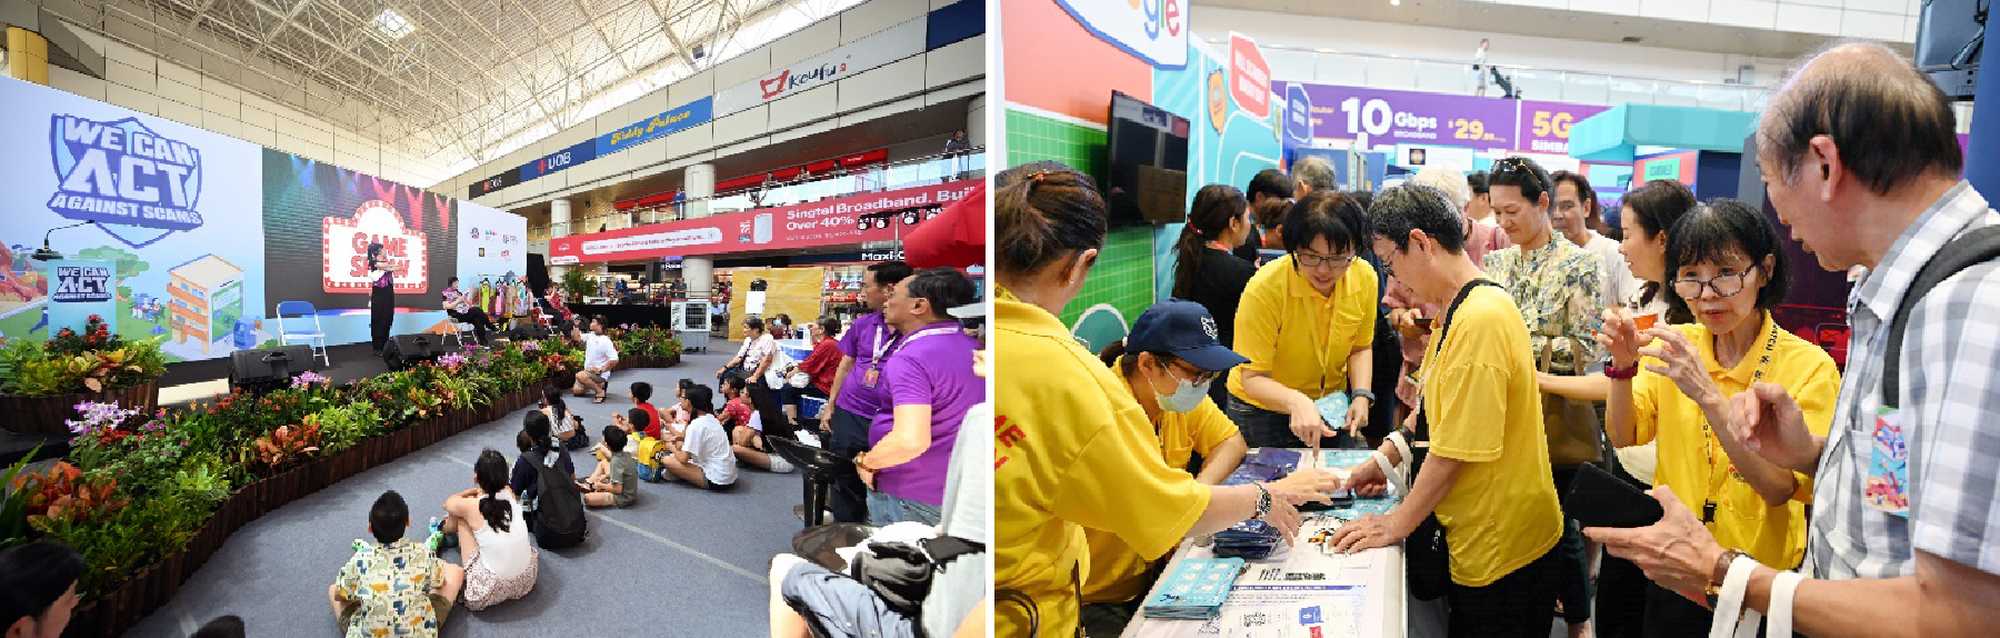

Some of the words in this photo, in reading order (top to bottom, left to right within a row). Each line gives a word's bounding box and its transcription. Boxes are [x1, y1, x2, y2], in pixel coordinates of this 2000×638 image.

[1131, 0, 1180, 41] gle
[1341, 97, 1393, 135] 10
[1394, 111, 1437, 131] Gbps
[1532, 110, 1573, 139] 5G
[64, 116, 124, 150] WE
[134, 132, 195, 165] CAN
[548, 152, 571, 169] UOB
[61, 149, 188, 207] ACT
[51, 194, 139, 217] AGAINST
[142, 205, 201, 224] SCAMS
[787, 205, 834, 220] Singtel
[836, 192, 932, 214] Broadband.
[787, 221, 817, 231] Over
[820, 215, 854, 229] 40%
[57, 276, 107, 293] ACT
[58, 266, 80, 277] WE
[83, 267, 108, 277] CAN
